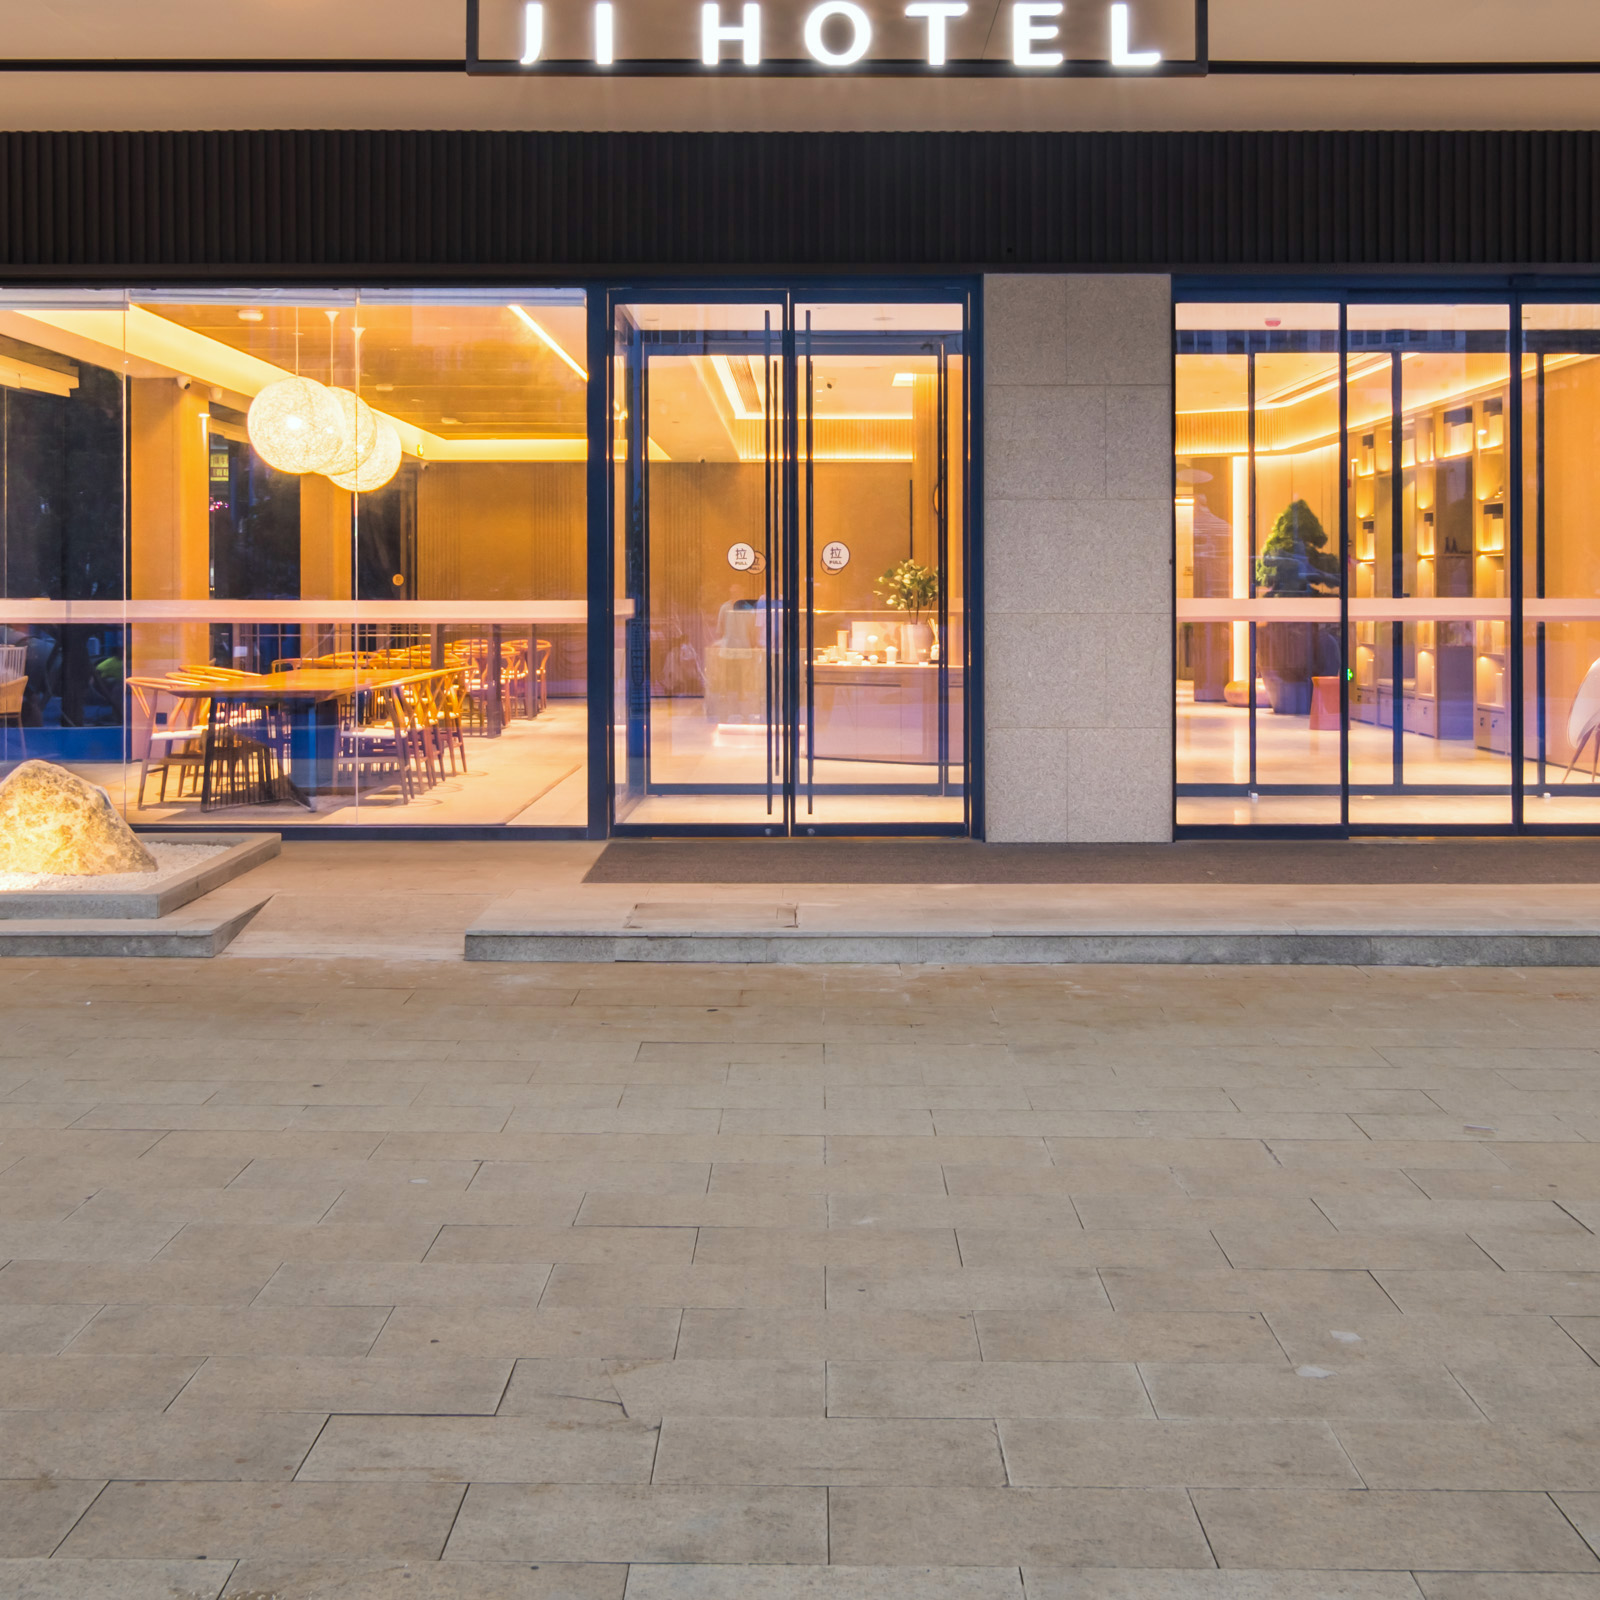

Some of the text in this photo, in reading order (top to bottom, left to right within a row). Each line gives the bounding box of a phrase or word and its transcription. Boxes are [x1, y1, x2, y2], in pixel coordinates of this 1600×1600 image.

[519, 0, 1162, 67] JI HOTEL
[735, 548, 748, 561] 拉
[830, 546, 842, 559] 拉
